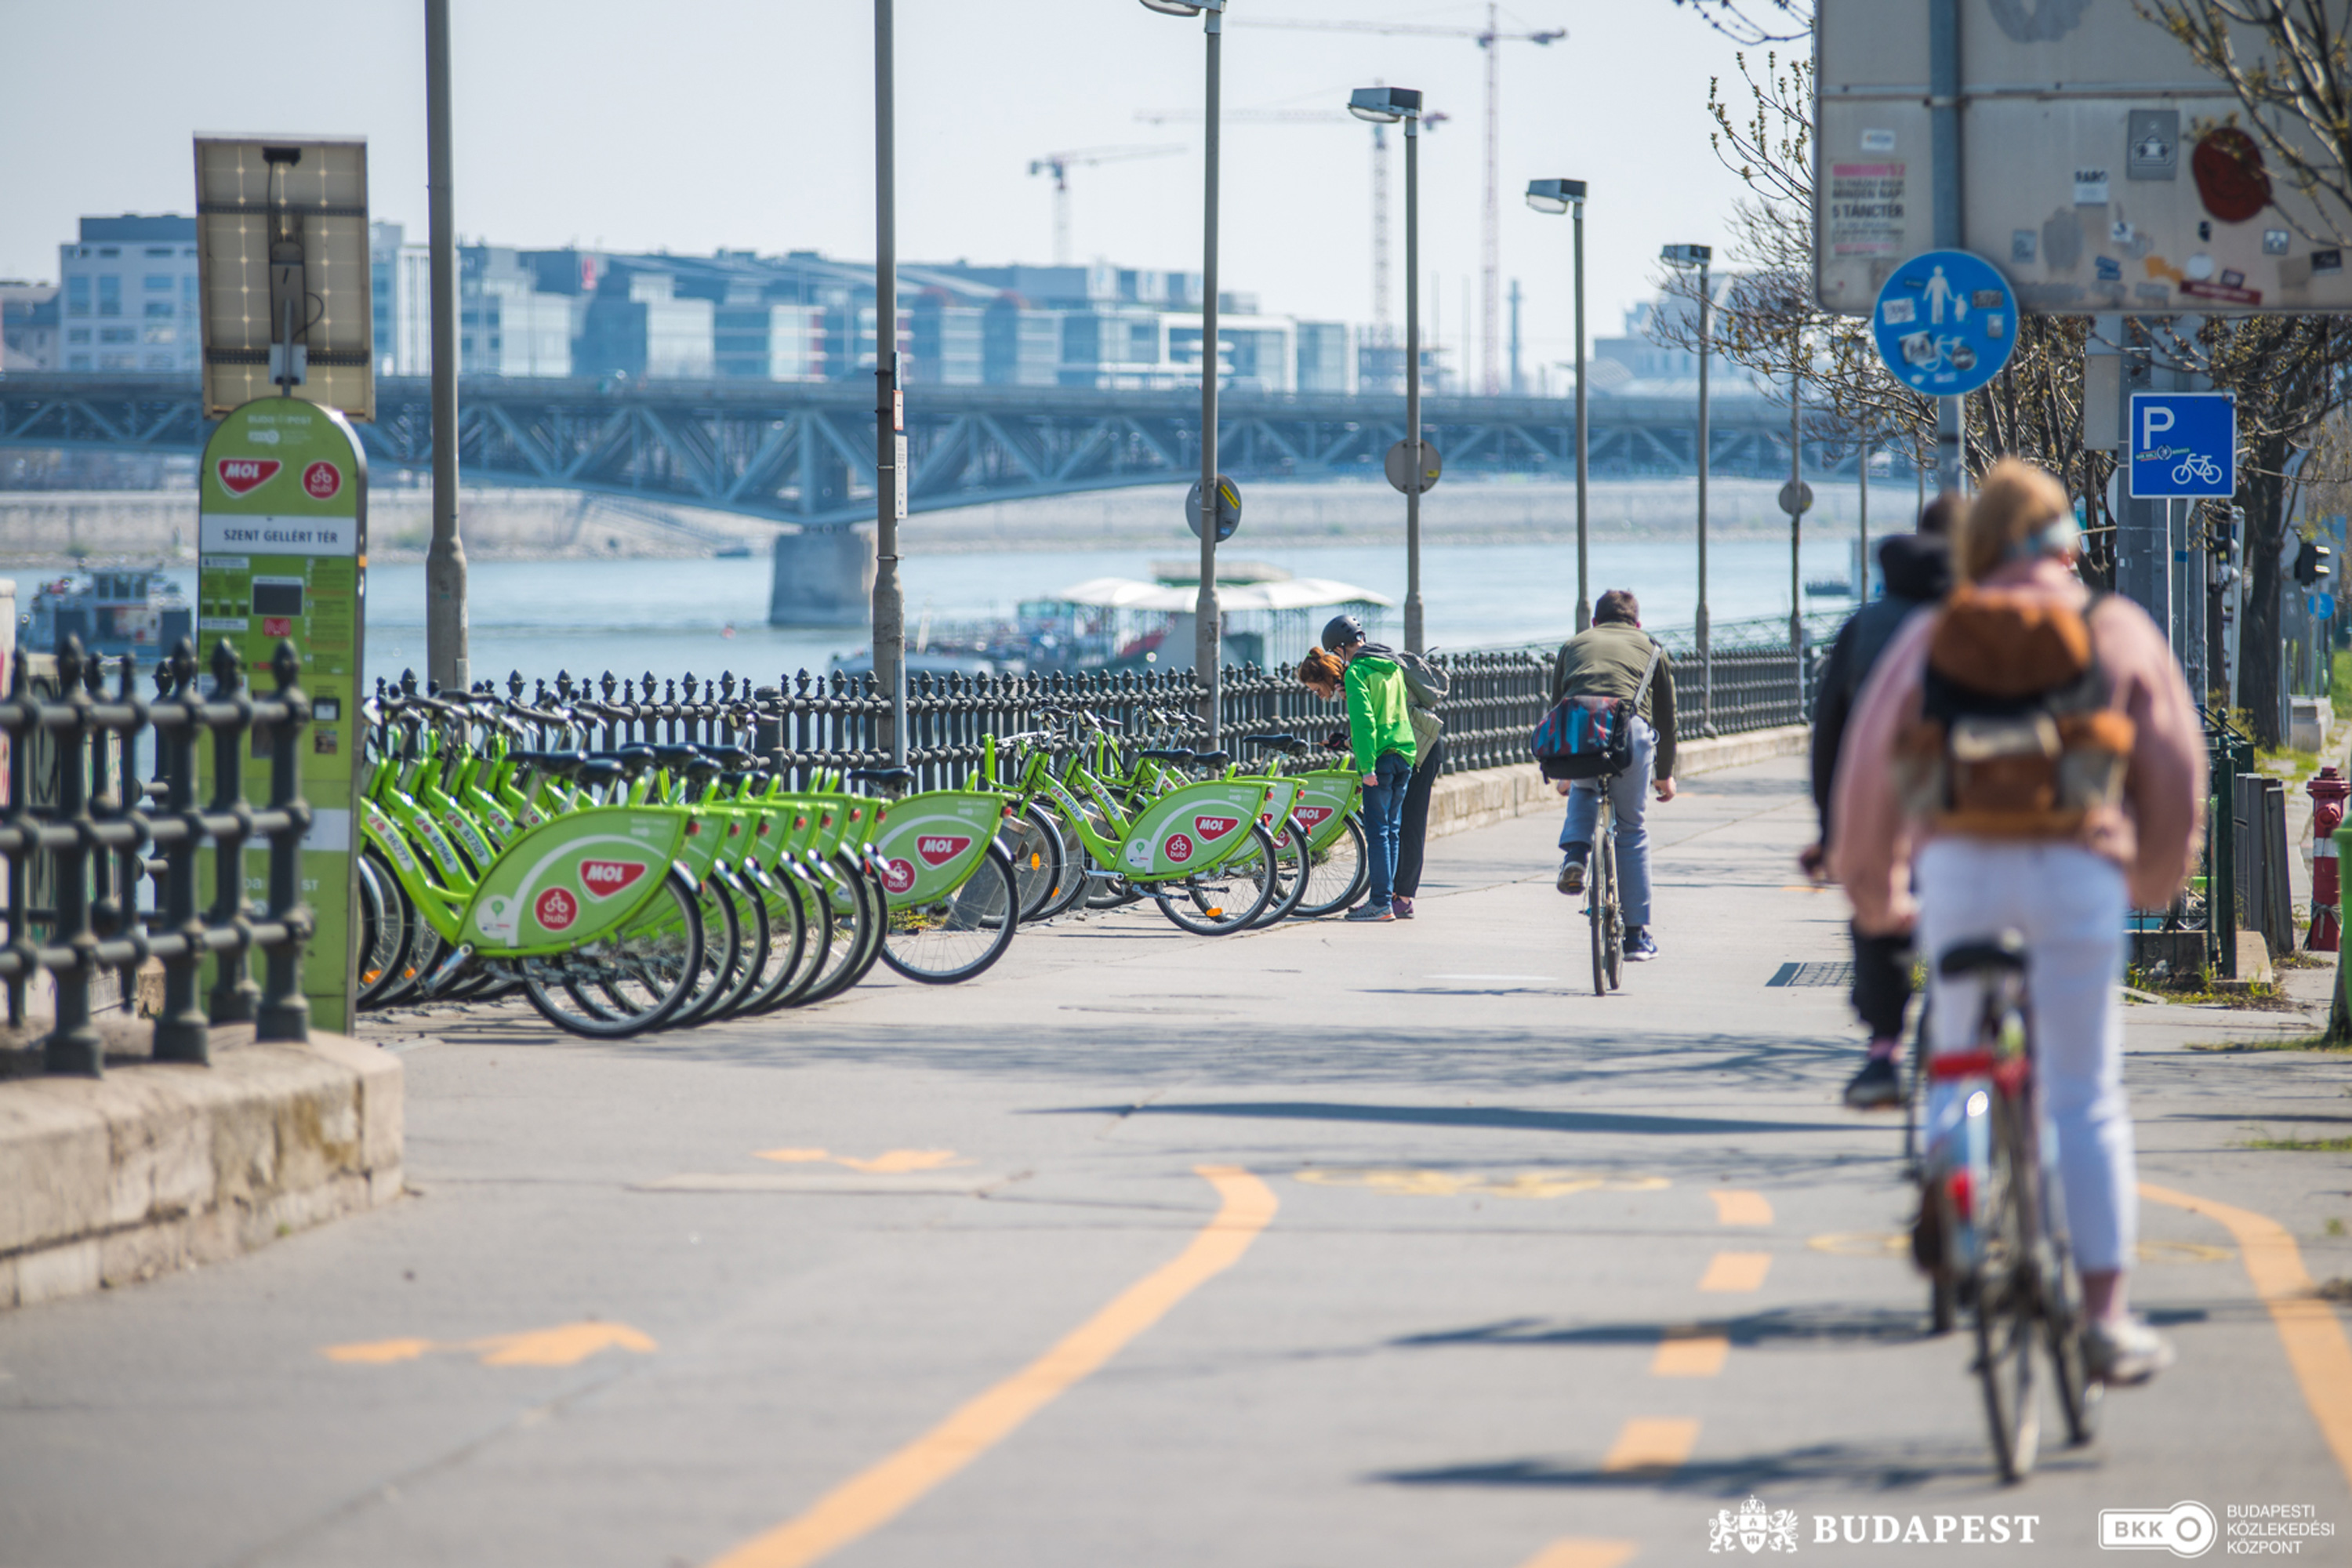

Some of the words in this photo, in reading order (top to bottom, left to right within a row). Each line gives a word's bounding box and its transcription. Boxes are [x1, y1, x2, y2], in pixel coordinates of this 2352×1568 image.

[2143, 406, 2175, 450] P
[225, 463, 260, 478] MOL
[310, 484, 332, 493] bubi
[224, 529, 260, 541] SZENT
[263, 528, 312, 543] GELLÉRT
[317, 530, 338, 543] TÉR
[1296, 808, 1319, 819] MOL
[1199, 819, 1225, 831] MOL
[386, 833, 409, 862] 86277
[463, 829, 485, 858] 87709
[922, 840, 953, 852] MOL
[586, 865, 623, 882] MOL
[887, 880, 908, 888] bubi
[543, 913, 568, 924] bubi
